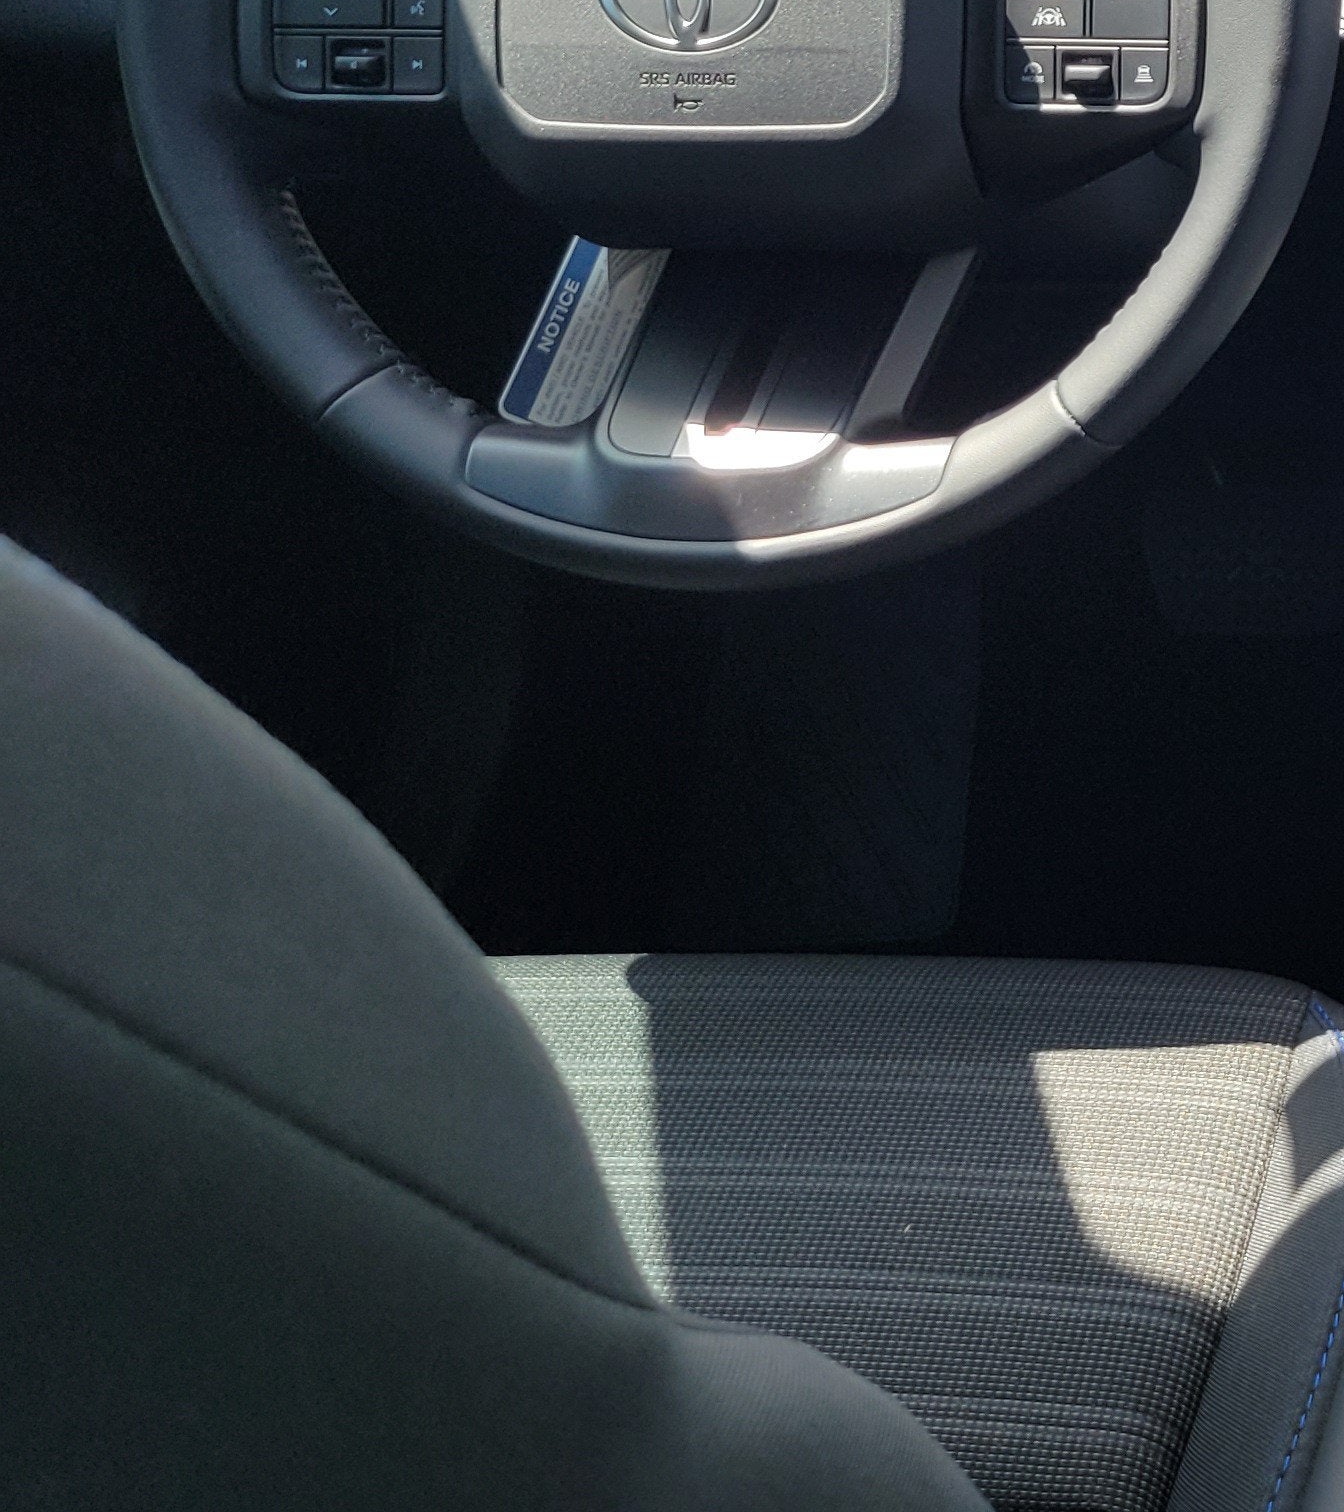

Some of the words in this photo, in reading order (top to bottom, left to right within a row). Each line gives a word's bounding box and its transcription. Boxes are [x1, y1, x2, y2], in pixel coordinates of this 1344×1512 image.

[640, 71, 670, 88] SRS
[674, 71, 737, 88] AIRBAG
[536, 277, 581, 354] NOTICE
